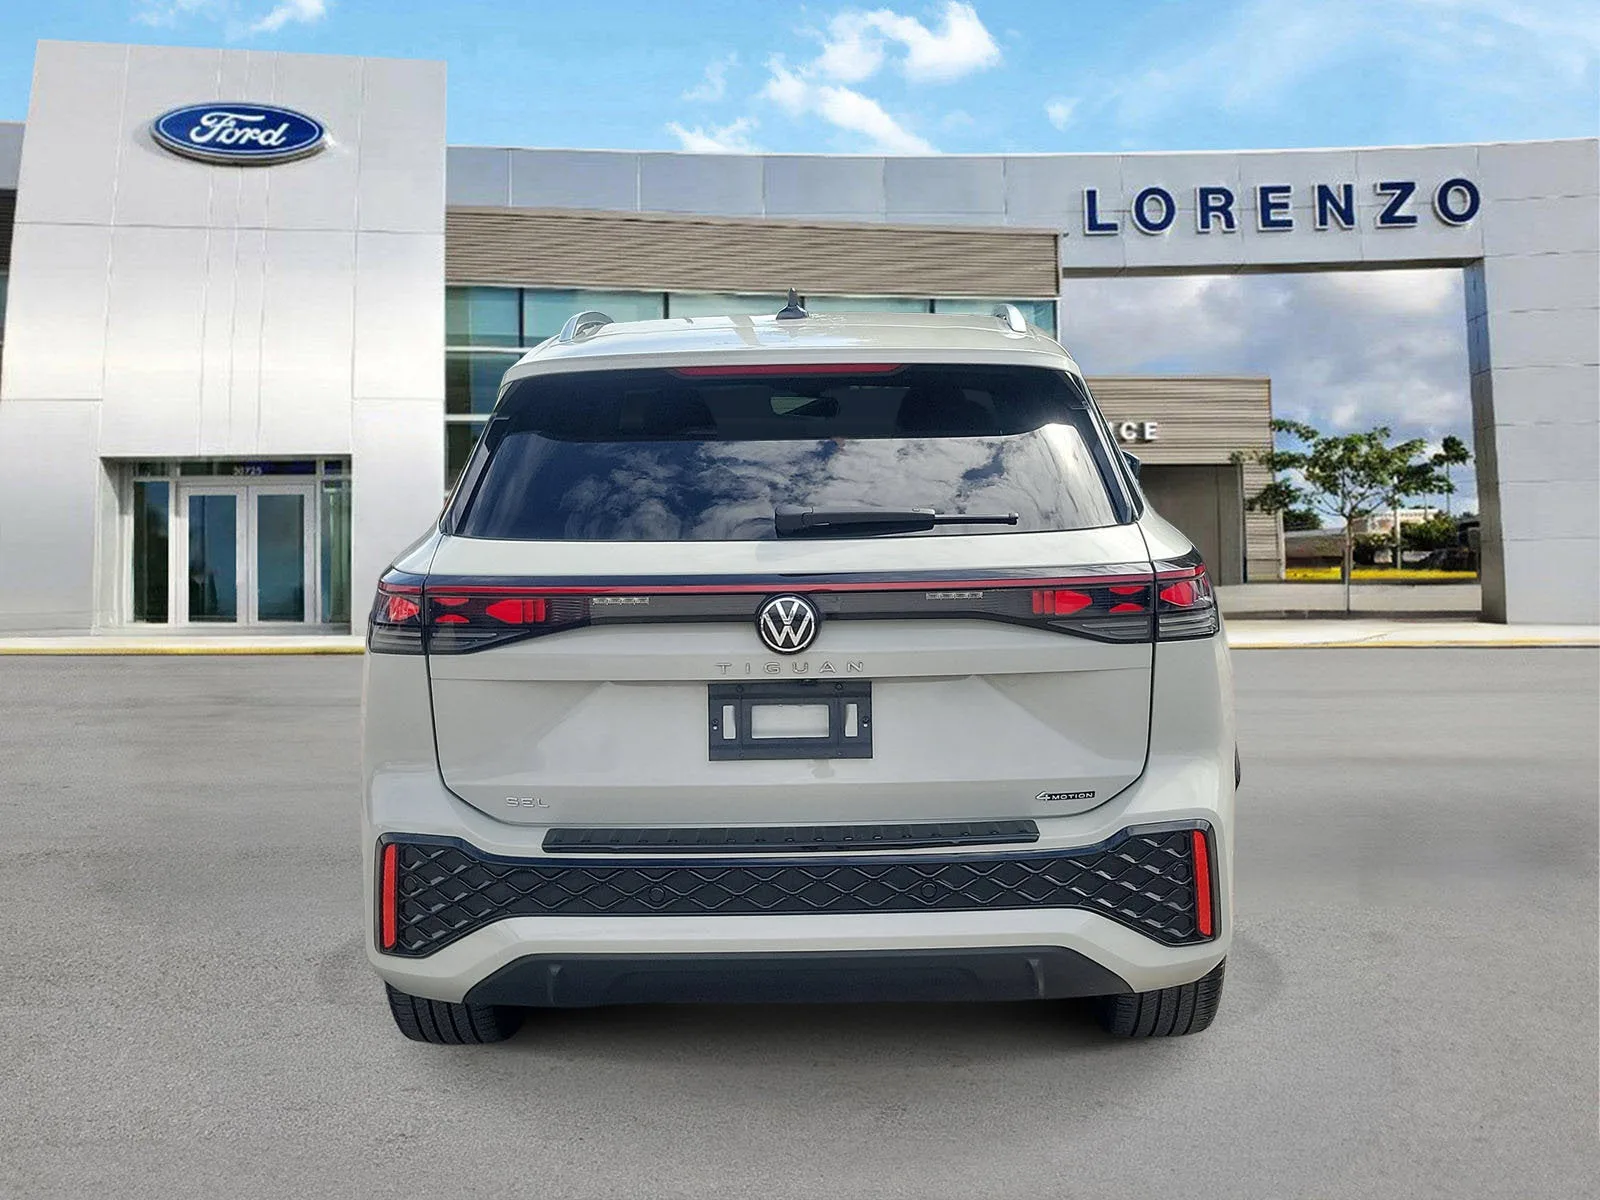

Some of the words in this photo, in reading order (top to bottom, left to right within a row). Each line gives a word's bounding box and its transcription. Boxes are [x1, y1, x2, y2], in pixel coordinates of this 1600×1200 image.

[190, 112, 290, 146] Ford
[1084, 178, 1480, 234] LORENZO
[716, 661, 864, 675] TIGUAN
[505, 797, 550, 808] SEL
